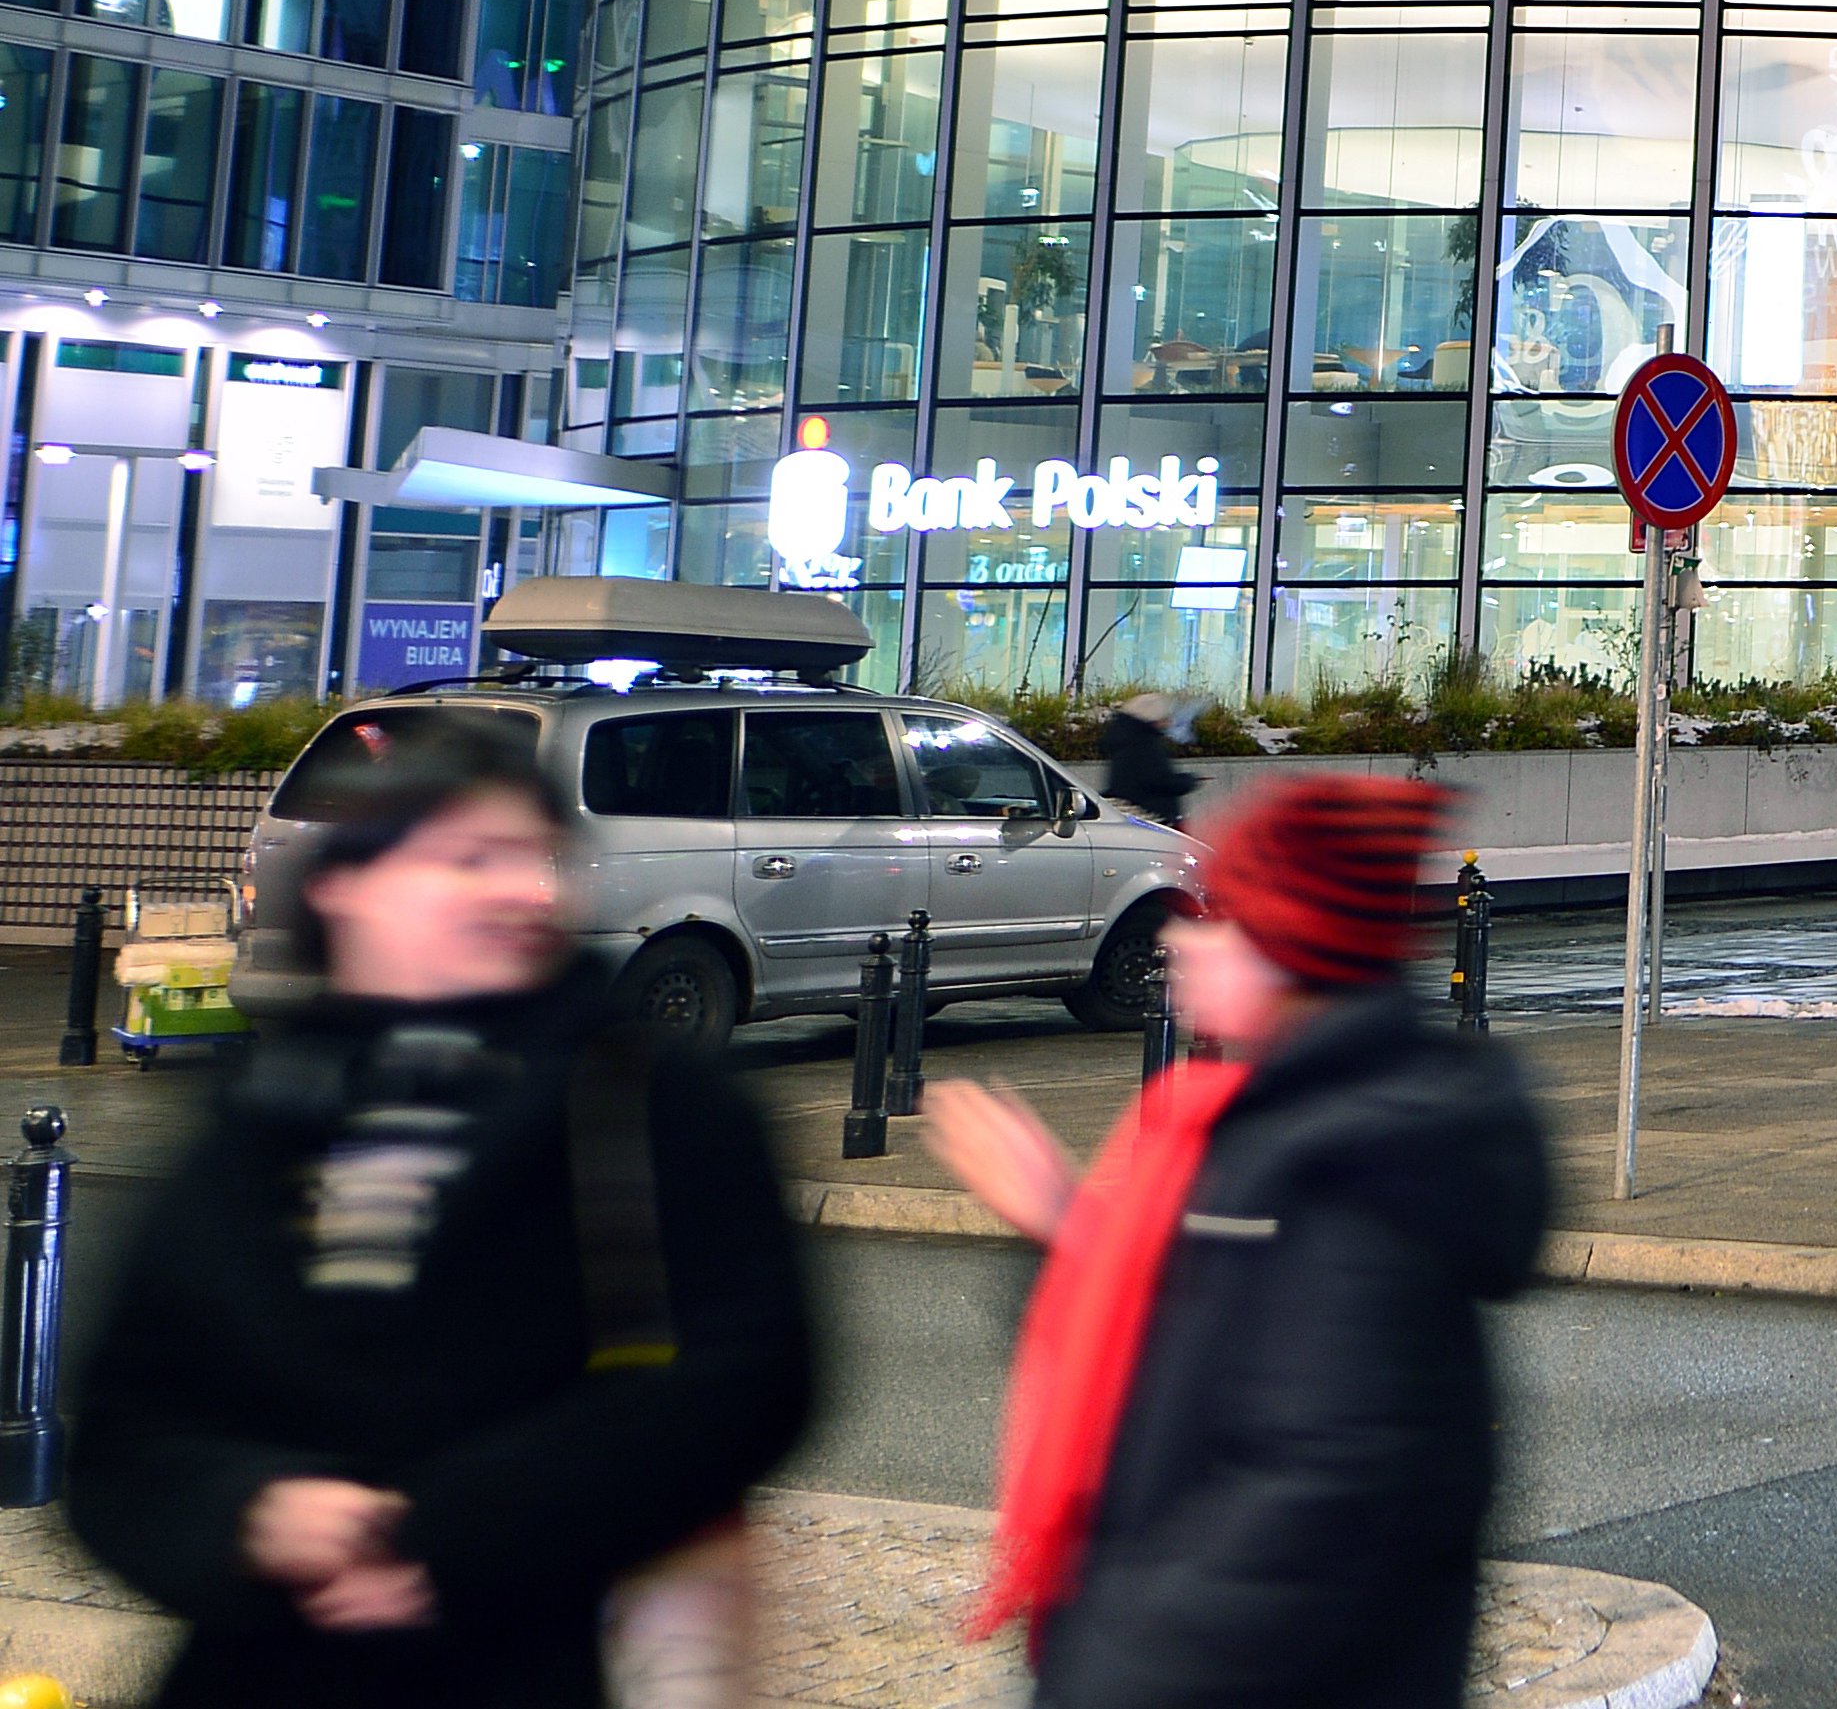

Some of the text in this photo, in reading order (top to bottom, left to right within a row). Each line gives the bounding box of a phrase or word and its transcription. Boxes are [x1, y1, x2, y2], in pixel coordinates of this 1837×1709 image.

[866, 453, 1220, 534] Bank Polski
[369, 619, 467, 640] WYNAJEM
[405, 646, 463, 666] BIURA
